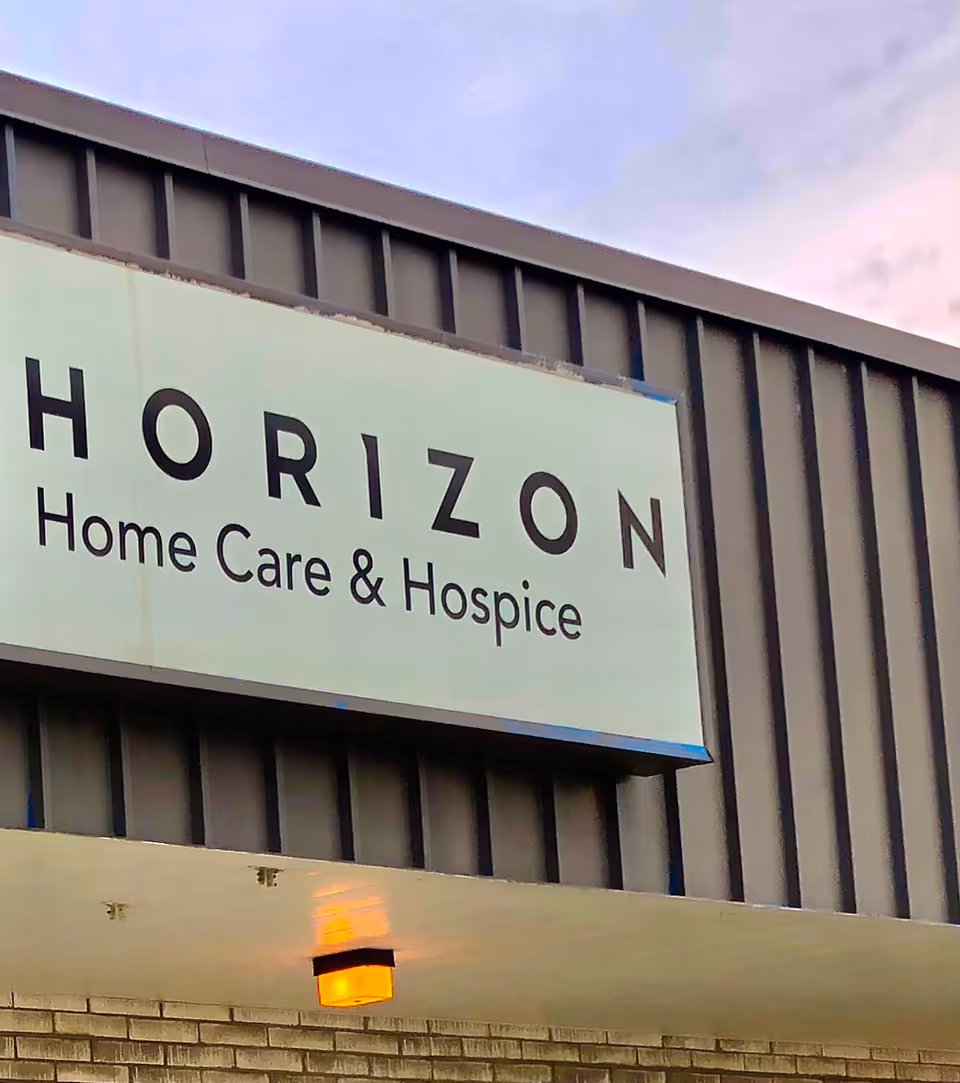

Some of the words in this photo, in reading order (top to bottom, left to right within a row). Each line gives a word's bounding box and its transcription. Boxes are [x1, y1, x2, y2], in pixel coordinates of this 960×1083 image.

[25, 356, 666, 578] HORIZON
[37, 486, 197, 572] Home
[216, 523, 332, 597] Care
[349, 548, 386, 607] &
[402, 556, 582, 647] Hospice
